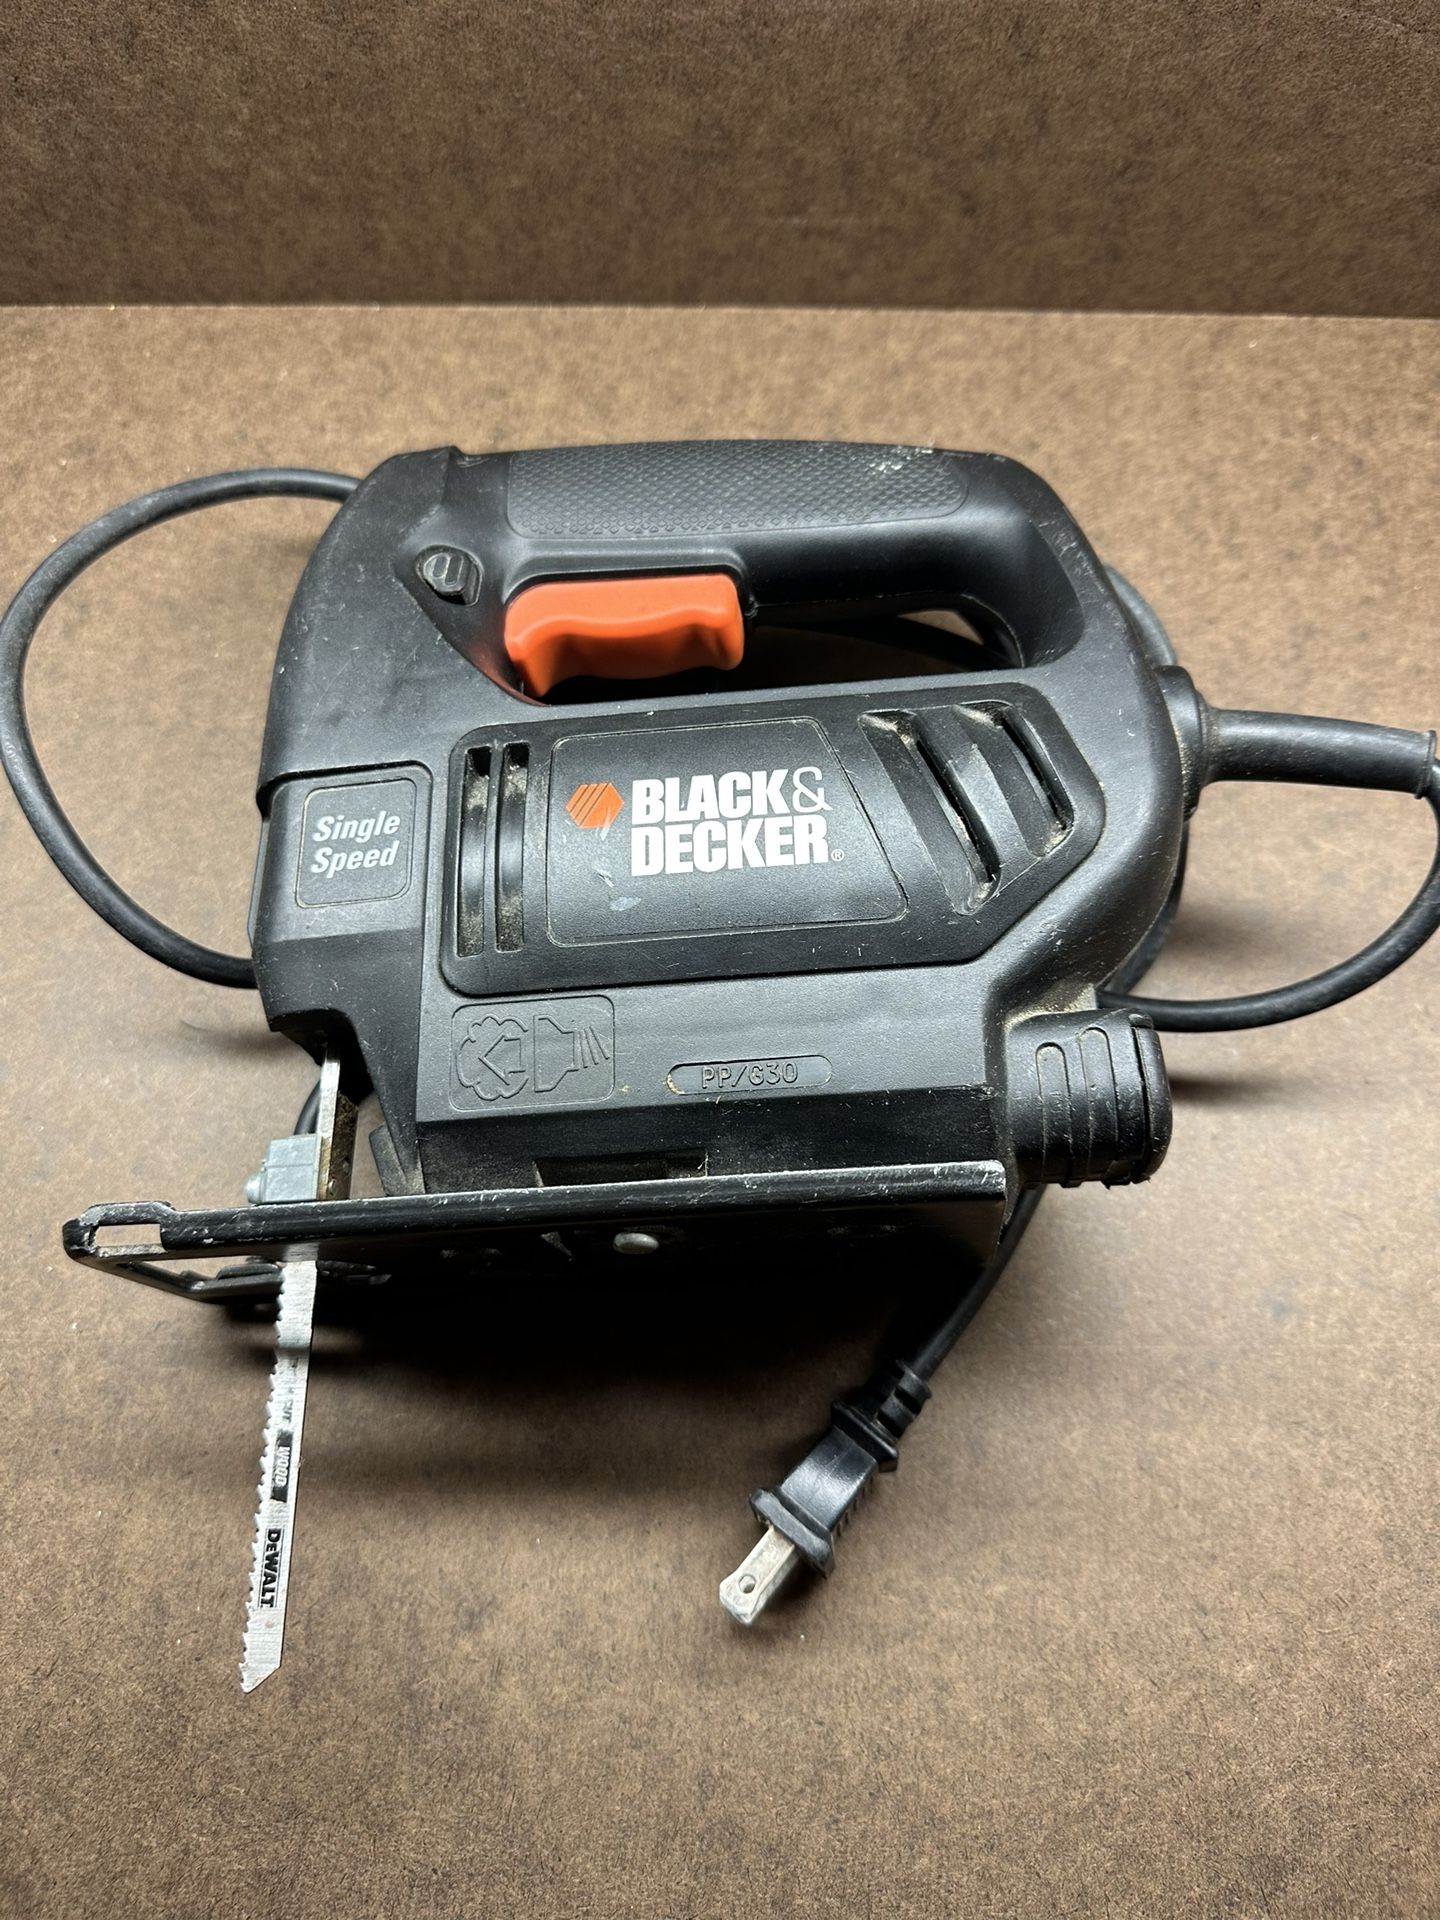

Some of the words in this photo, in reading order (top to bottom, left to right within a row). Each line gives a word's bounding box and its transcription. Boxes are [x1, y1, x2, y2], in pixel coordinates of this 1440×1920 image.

[312, 810, 401, 843] Single
[310, 840, 400, 879] Speed
[701, 1062, 798, 1089] PP/G30
[274, 1446, 291, 1487] WOOD
[260, 1528, 282, 1608] DEWALT
